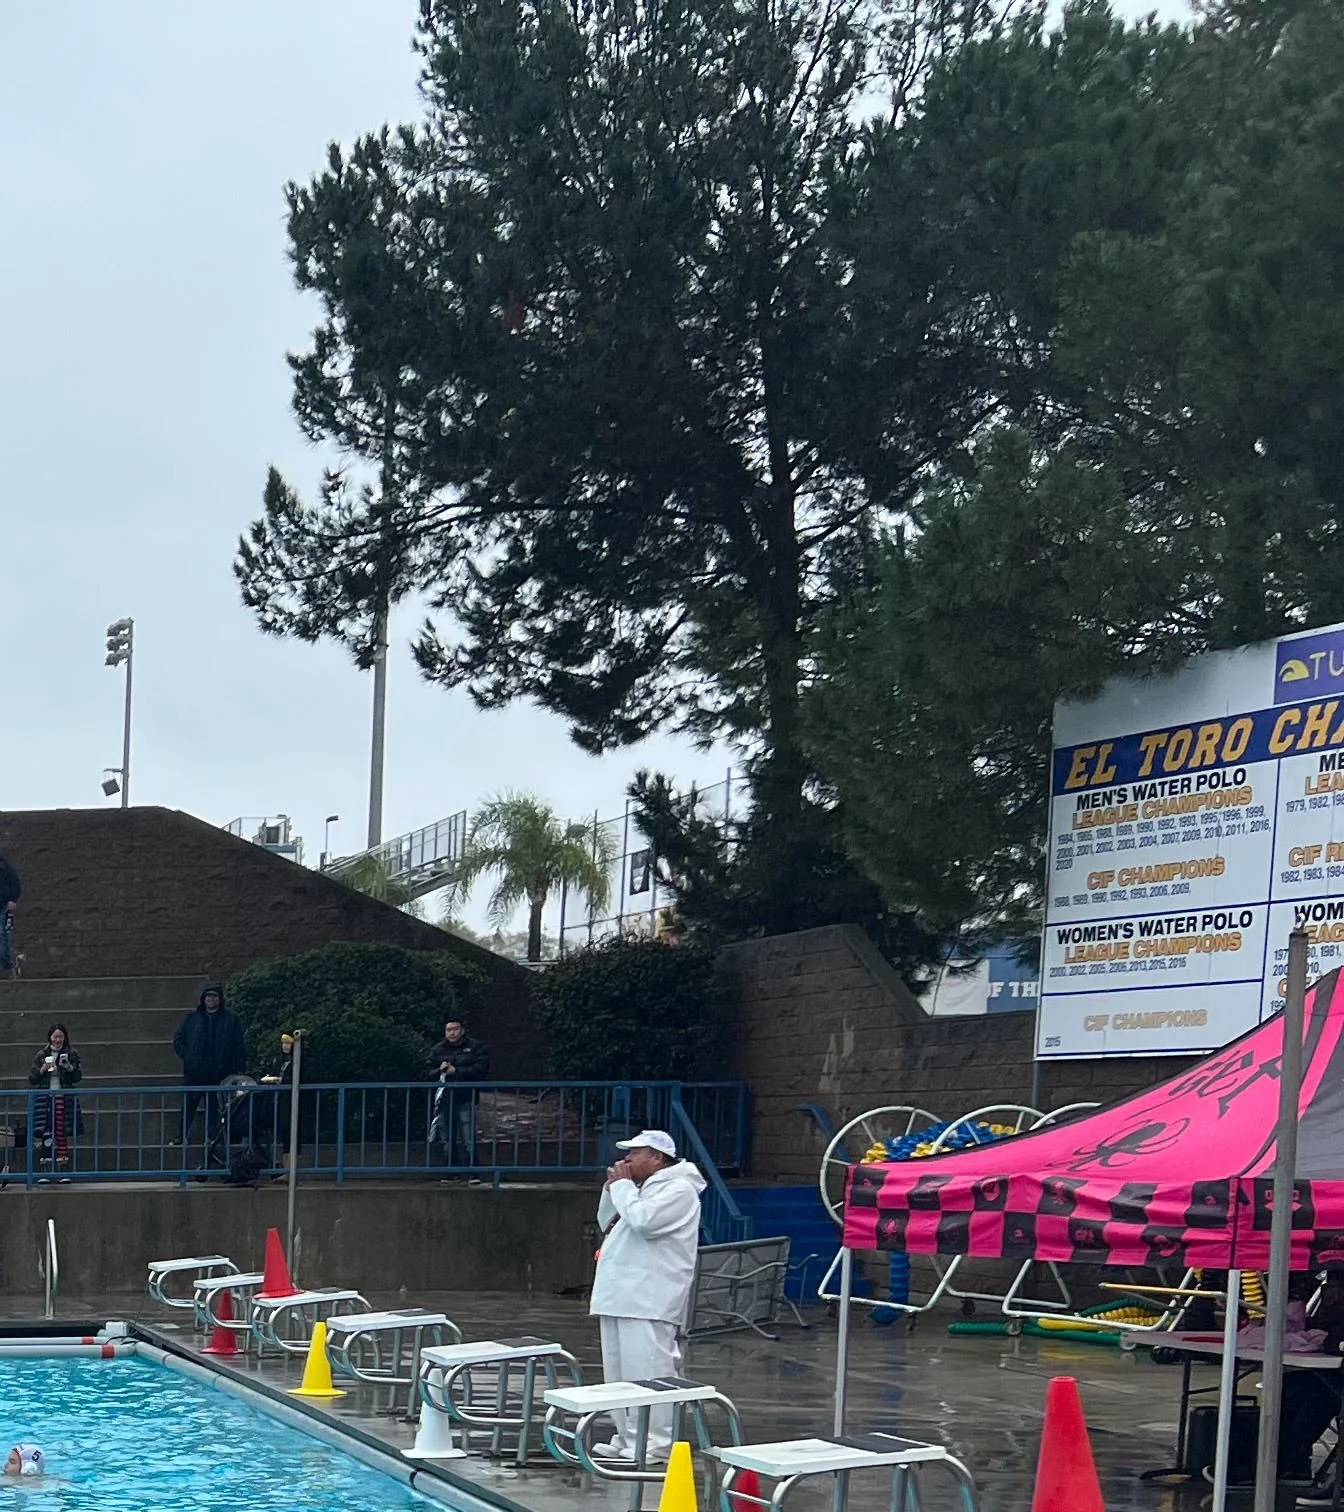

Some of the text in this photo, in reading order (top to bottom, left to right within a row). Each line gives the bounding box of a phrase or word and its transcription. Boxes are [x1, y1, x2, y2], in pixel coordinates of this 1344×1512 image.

[1063, 743, 1118, 790] EL
[1138, 717, 1255, 778] TORO
[1076, 767, 1247, 812] MEN'S WATER POLO
[1072, 785, 1253, 831] LEAGUE CHAMPIONS
[1086, 855, 1225, 891] CIF CHAMPIONS
[1288, 844, 1323, 868] CIF
[1057, 910, 1253, 945] WOMEN'S WATER POLO
[1064, 931, 1242, 964] LEAGUE CHAMPIONS
[1083, 1008, 1209, 1032] CIF CHAMPIONS
[31, 1450, 42, 1463] 5
